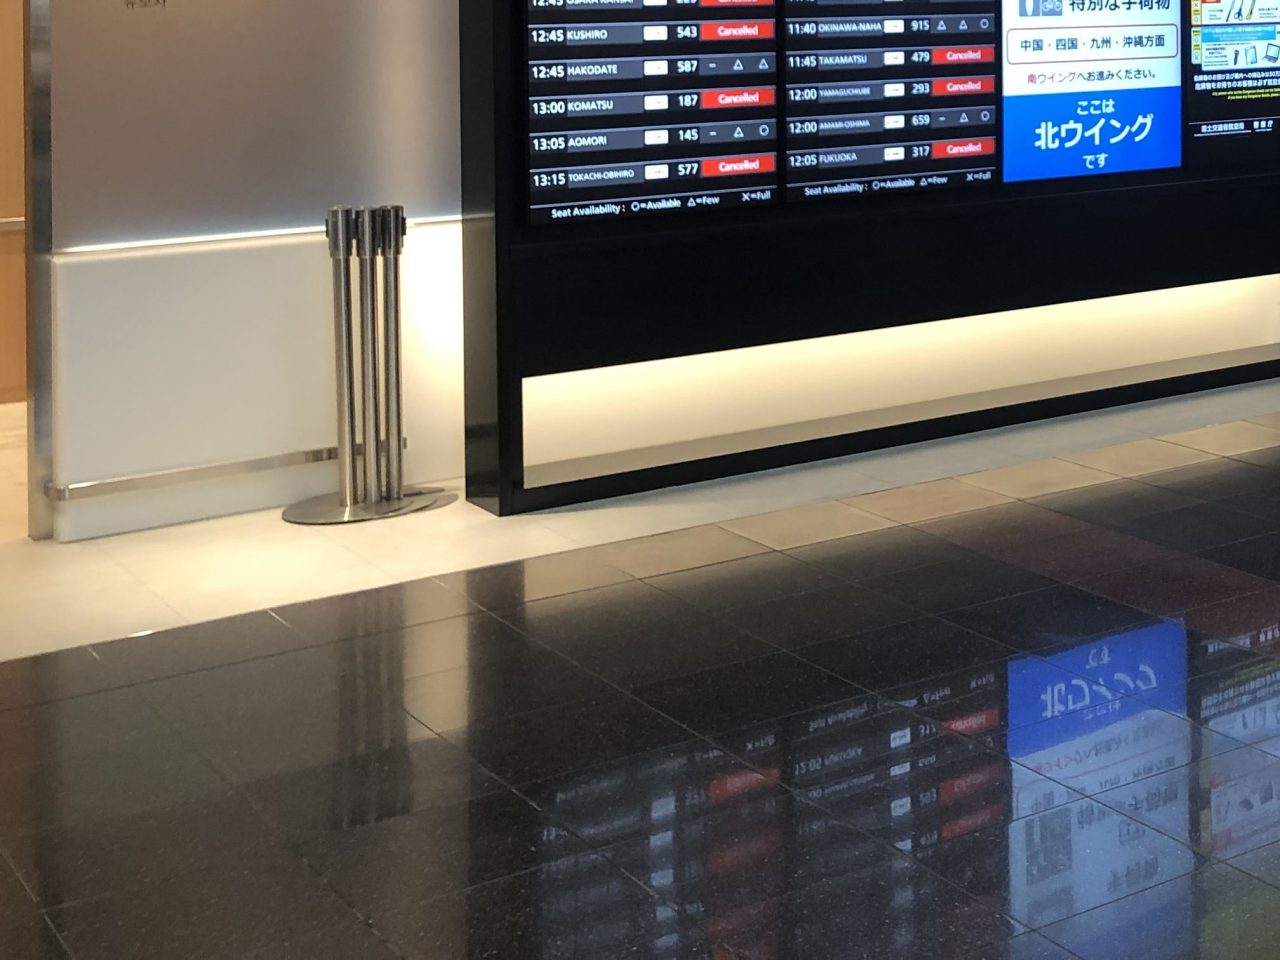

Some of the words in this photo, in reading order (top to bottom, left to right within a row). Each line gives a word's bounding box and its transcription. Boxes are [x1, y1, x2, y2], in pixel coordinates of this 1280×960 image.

[532, 30, 564, 42] 12:45
[567, 30, 607, 40] KUSHIRO
[677, 26, 697, 37] 543
[718, 25, 758, 36] Cancelled
[788, 23, 816, 34] 11:40
[819, 22, 882, 32] OKINAWA-NAHA
[911, 20, 929, 31] 915
[789, 56, 816, 67] 11:45
[819, 55, 867, 65] TAKAMATSU
[912, 52, 930, 62] 479
[946, 51, 981, 60] Cancelled
[532, 66, 564, 78] 12:45
[568, 65, 617, 75] HAKODATE
[678, 60, 697, 72] 587
[1027, 69, 1157, 84] 南ウイングへお進みください。
[789, 89, 817, 100] 12:00
[912, 83, 930, 94] 293
[947, 82, 981, 91] Cancelled
[533, 102, 565, 114] 13:00
[568, 101, 613, 111] KOMATSU
[679, 95, 697, 106] 187
[718, 92, 759, 104] Cancelled
[1077, 99, 1115, 115] ここは
[789, 122, 817, 133] 12:00
[912, 115, 930, 125] 659
[1034, 113, 1154, 149] 北ウイング
[533, 138, 566, 150] 13:05
[568, 136, 607, 147] AOMORI
[679, 129, 698, 140] 145
[790, 154, 817, 166] 12:05
[820, 153, 857, 163] FUKUOKA
[913, 147, 930, 157] 317
[947, 143, 982, 153] Cancelled
[1083, 153, 1108, 168] です
[534, 174, 566, 186] 13:15
[569, 170, 634, 182] TOKACHI-OBIHIRO
[678, 163, 698, 175] 577
[719, 160, 759, 171] Cancelled
[805, 187, 822, 196] Seat
[552, 208, 571, 218] Seat
